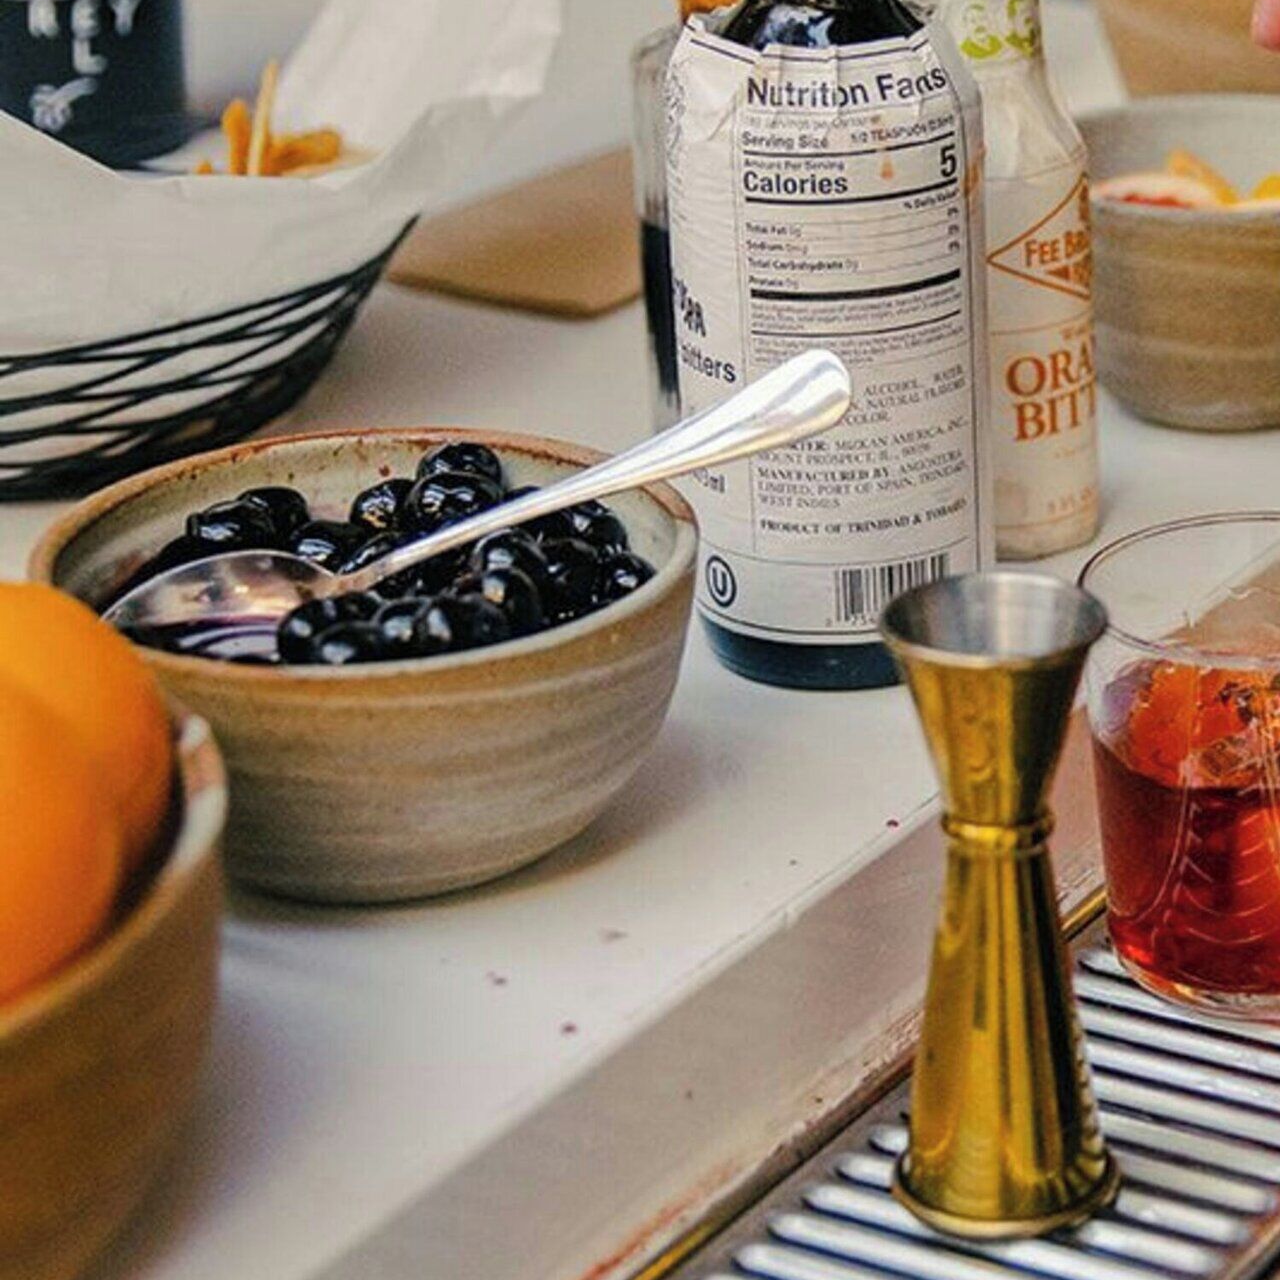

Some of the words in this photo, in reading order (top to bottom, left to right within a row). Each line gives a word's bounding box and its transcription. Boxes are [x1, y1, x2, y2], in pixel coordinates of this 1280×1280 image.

[742, 131, 795, 150] Serving
[799, 133, 828, 149] Size
[940, 144, 957, 178] 5
[743, 171, 849, 195] Calories
[1024, 238, 1060, 268] FEE
[760, 518, 821, 535] PRODUCT
[825, 522, 843, 535] OF
[848, 517, 910, 535] TRINIDAD
